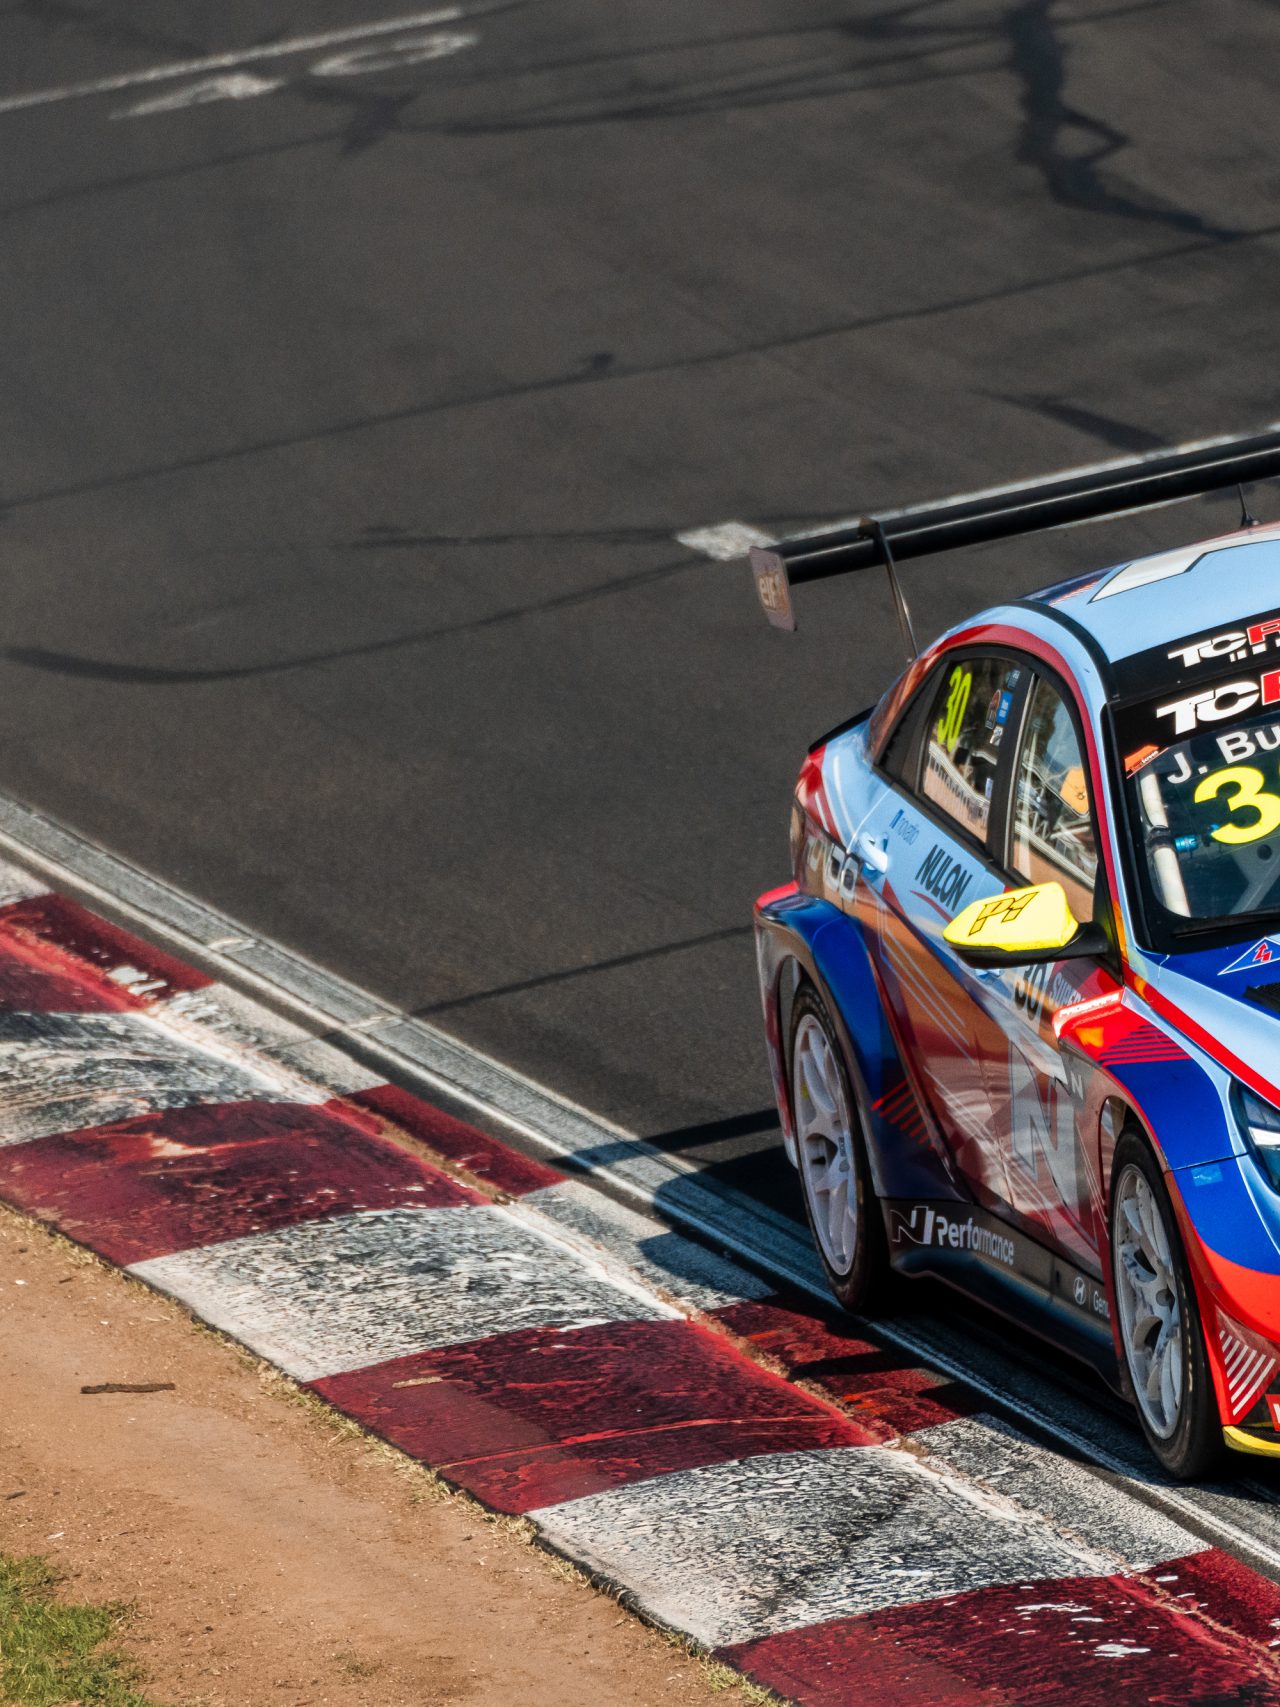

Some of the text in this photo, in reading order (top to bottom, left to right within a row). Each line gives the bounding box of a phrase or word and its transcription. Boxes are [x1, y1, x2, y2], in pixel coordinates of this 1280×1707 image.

[937, 665, 972, 752] 30
[1167, 752, 1207, 784] J.
[915, 844, 973, 912] NULON
[968, 891, 1040, 936] P1
[936, 1216, 1014, 1266] Performance
